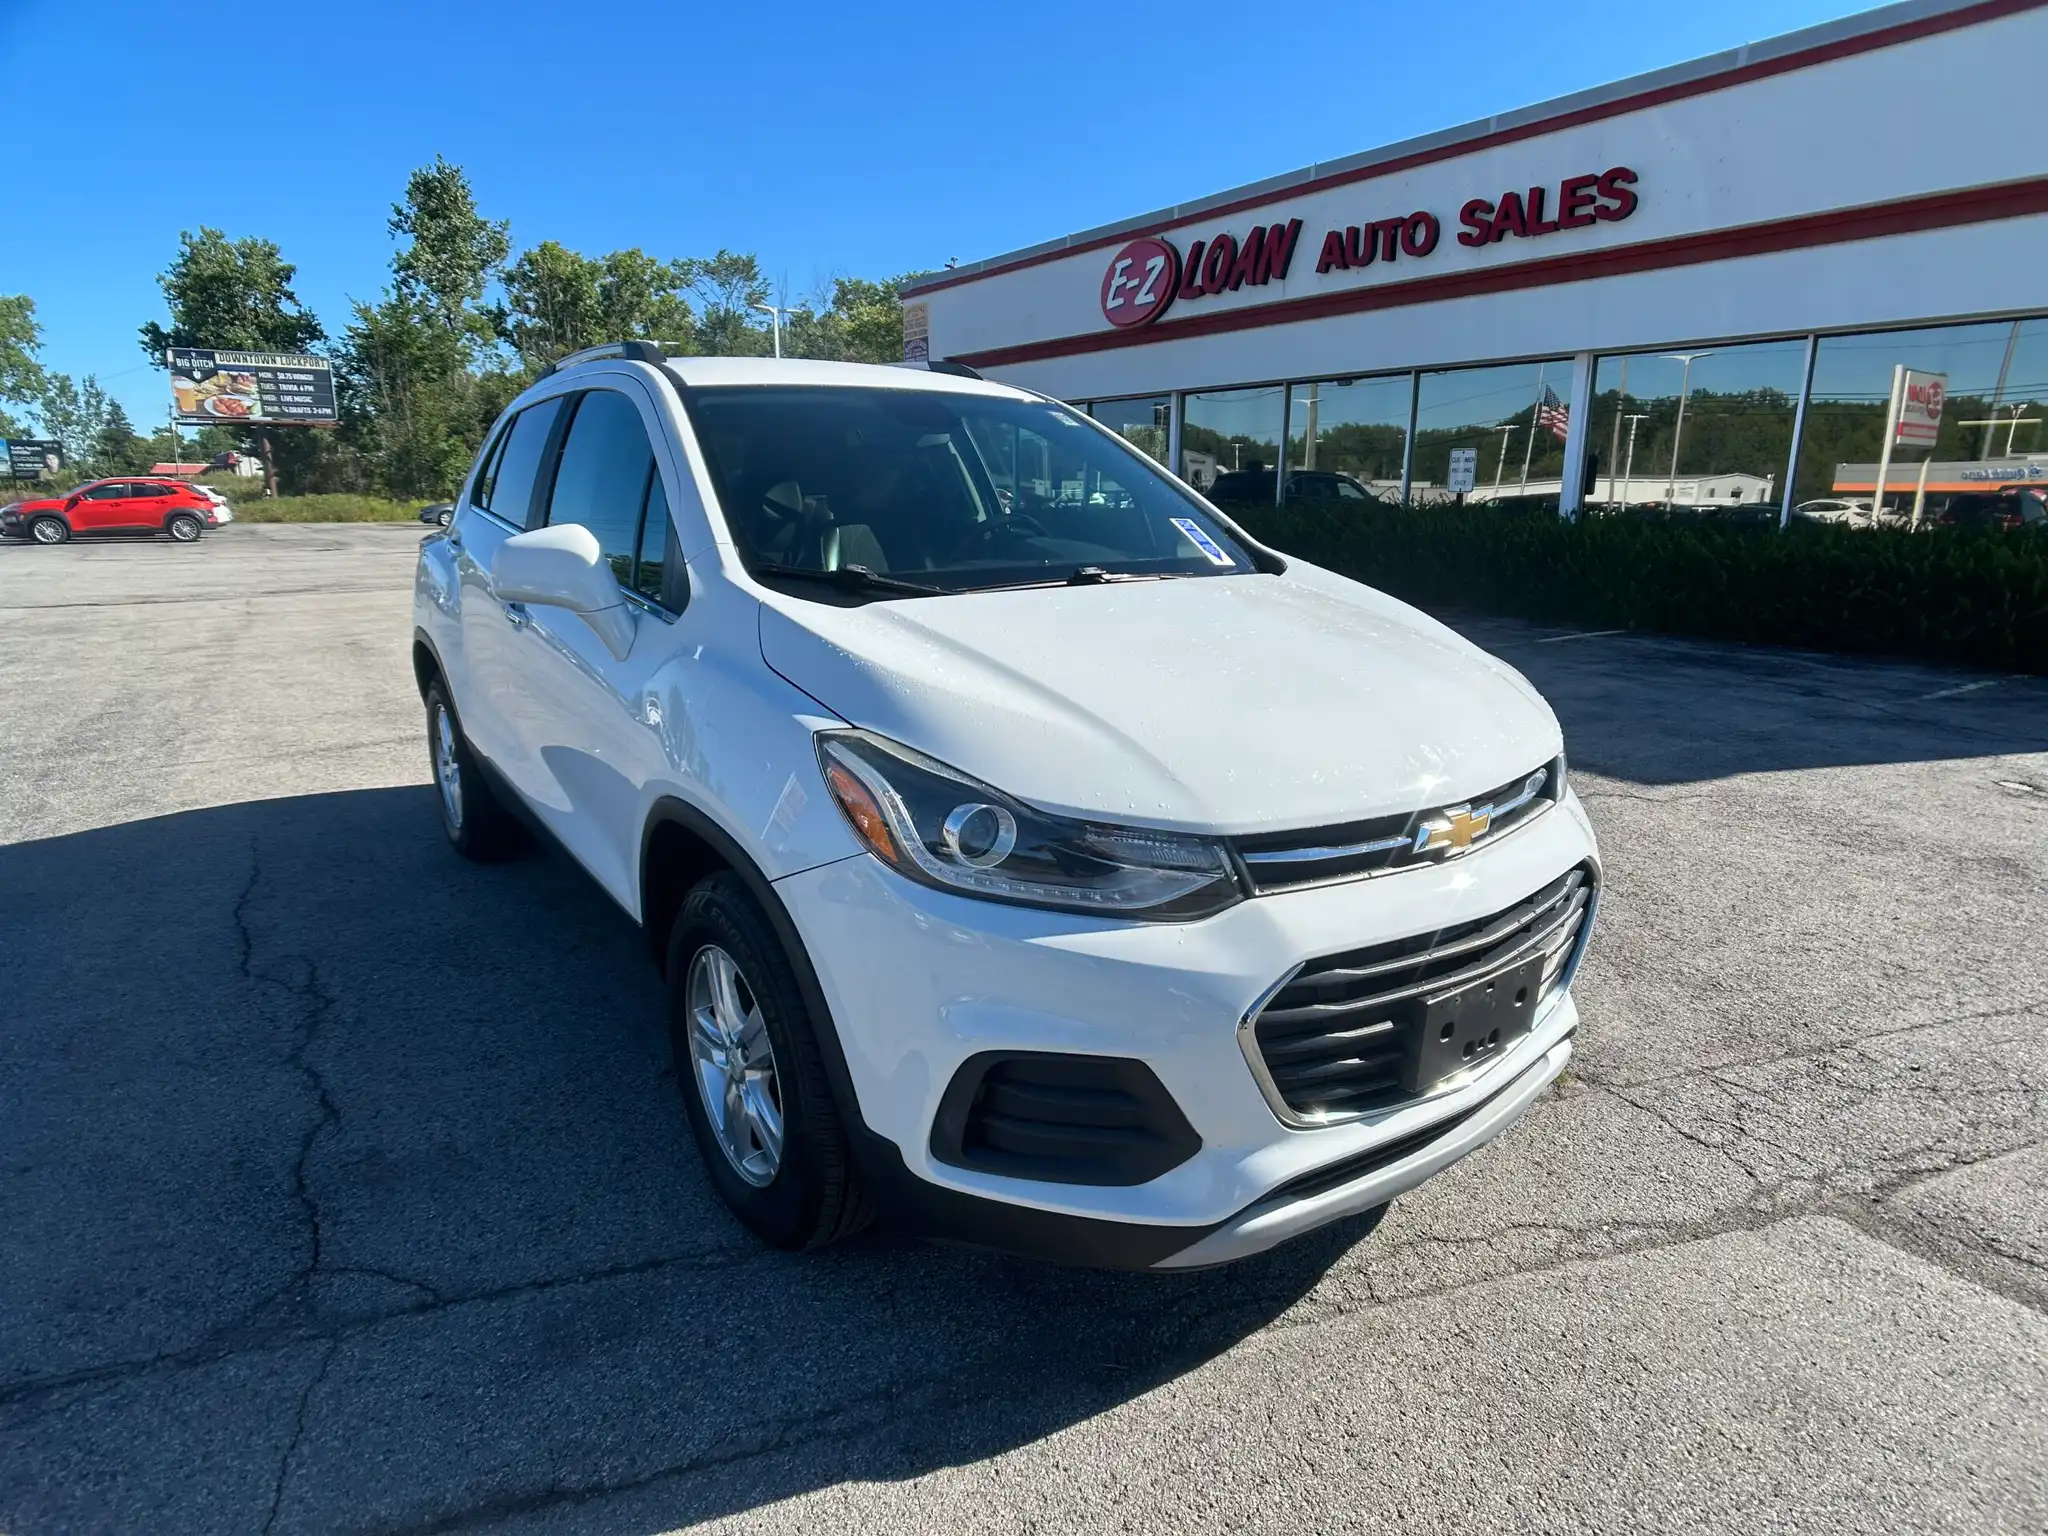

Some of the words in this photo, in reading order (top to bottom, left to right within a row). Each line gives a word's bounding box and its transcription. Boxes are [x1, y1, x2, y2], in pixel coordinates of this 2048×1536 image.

[1105, 254, 1167, 309] E-Z
[1178, 218, 1305, 300] LOAN
[1315, 210, 1440, 274] AUTO
[1457, 167, 1638, 247] SALES
[175, 357, 190, 367] BIG
[191, 358, 215, 369] DITCH
[218, 352, 277, 365] DOWNTOWN
[280, 356, 326, 368] LOCKPORT
